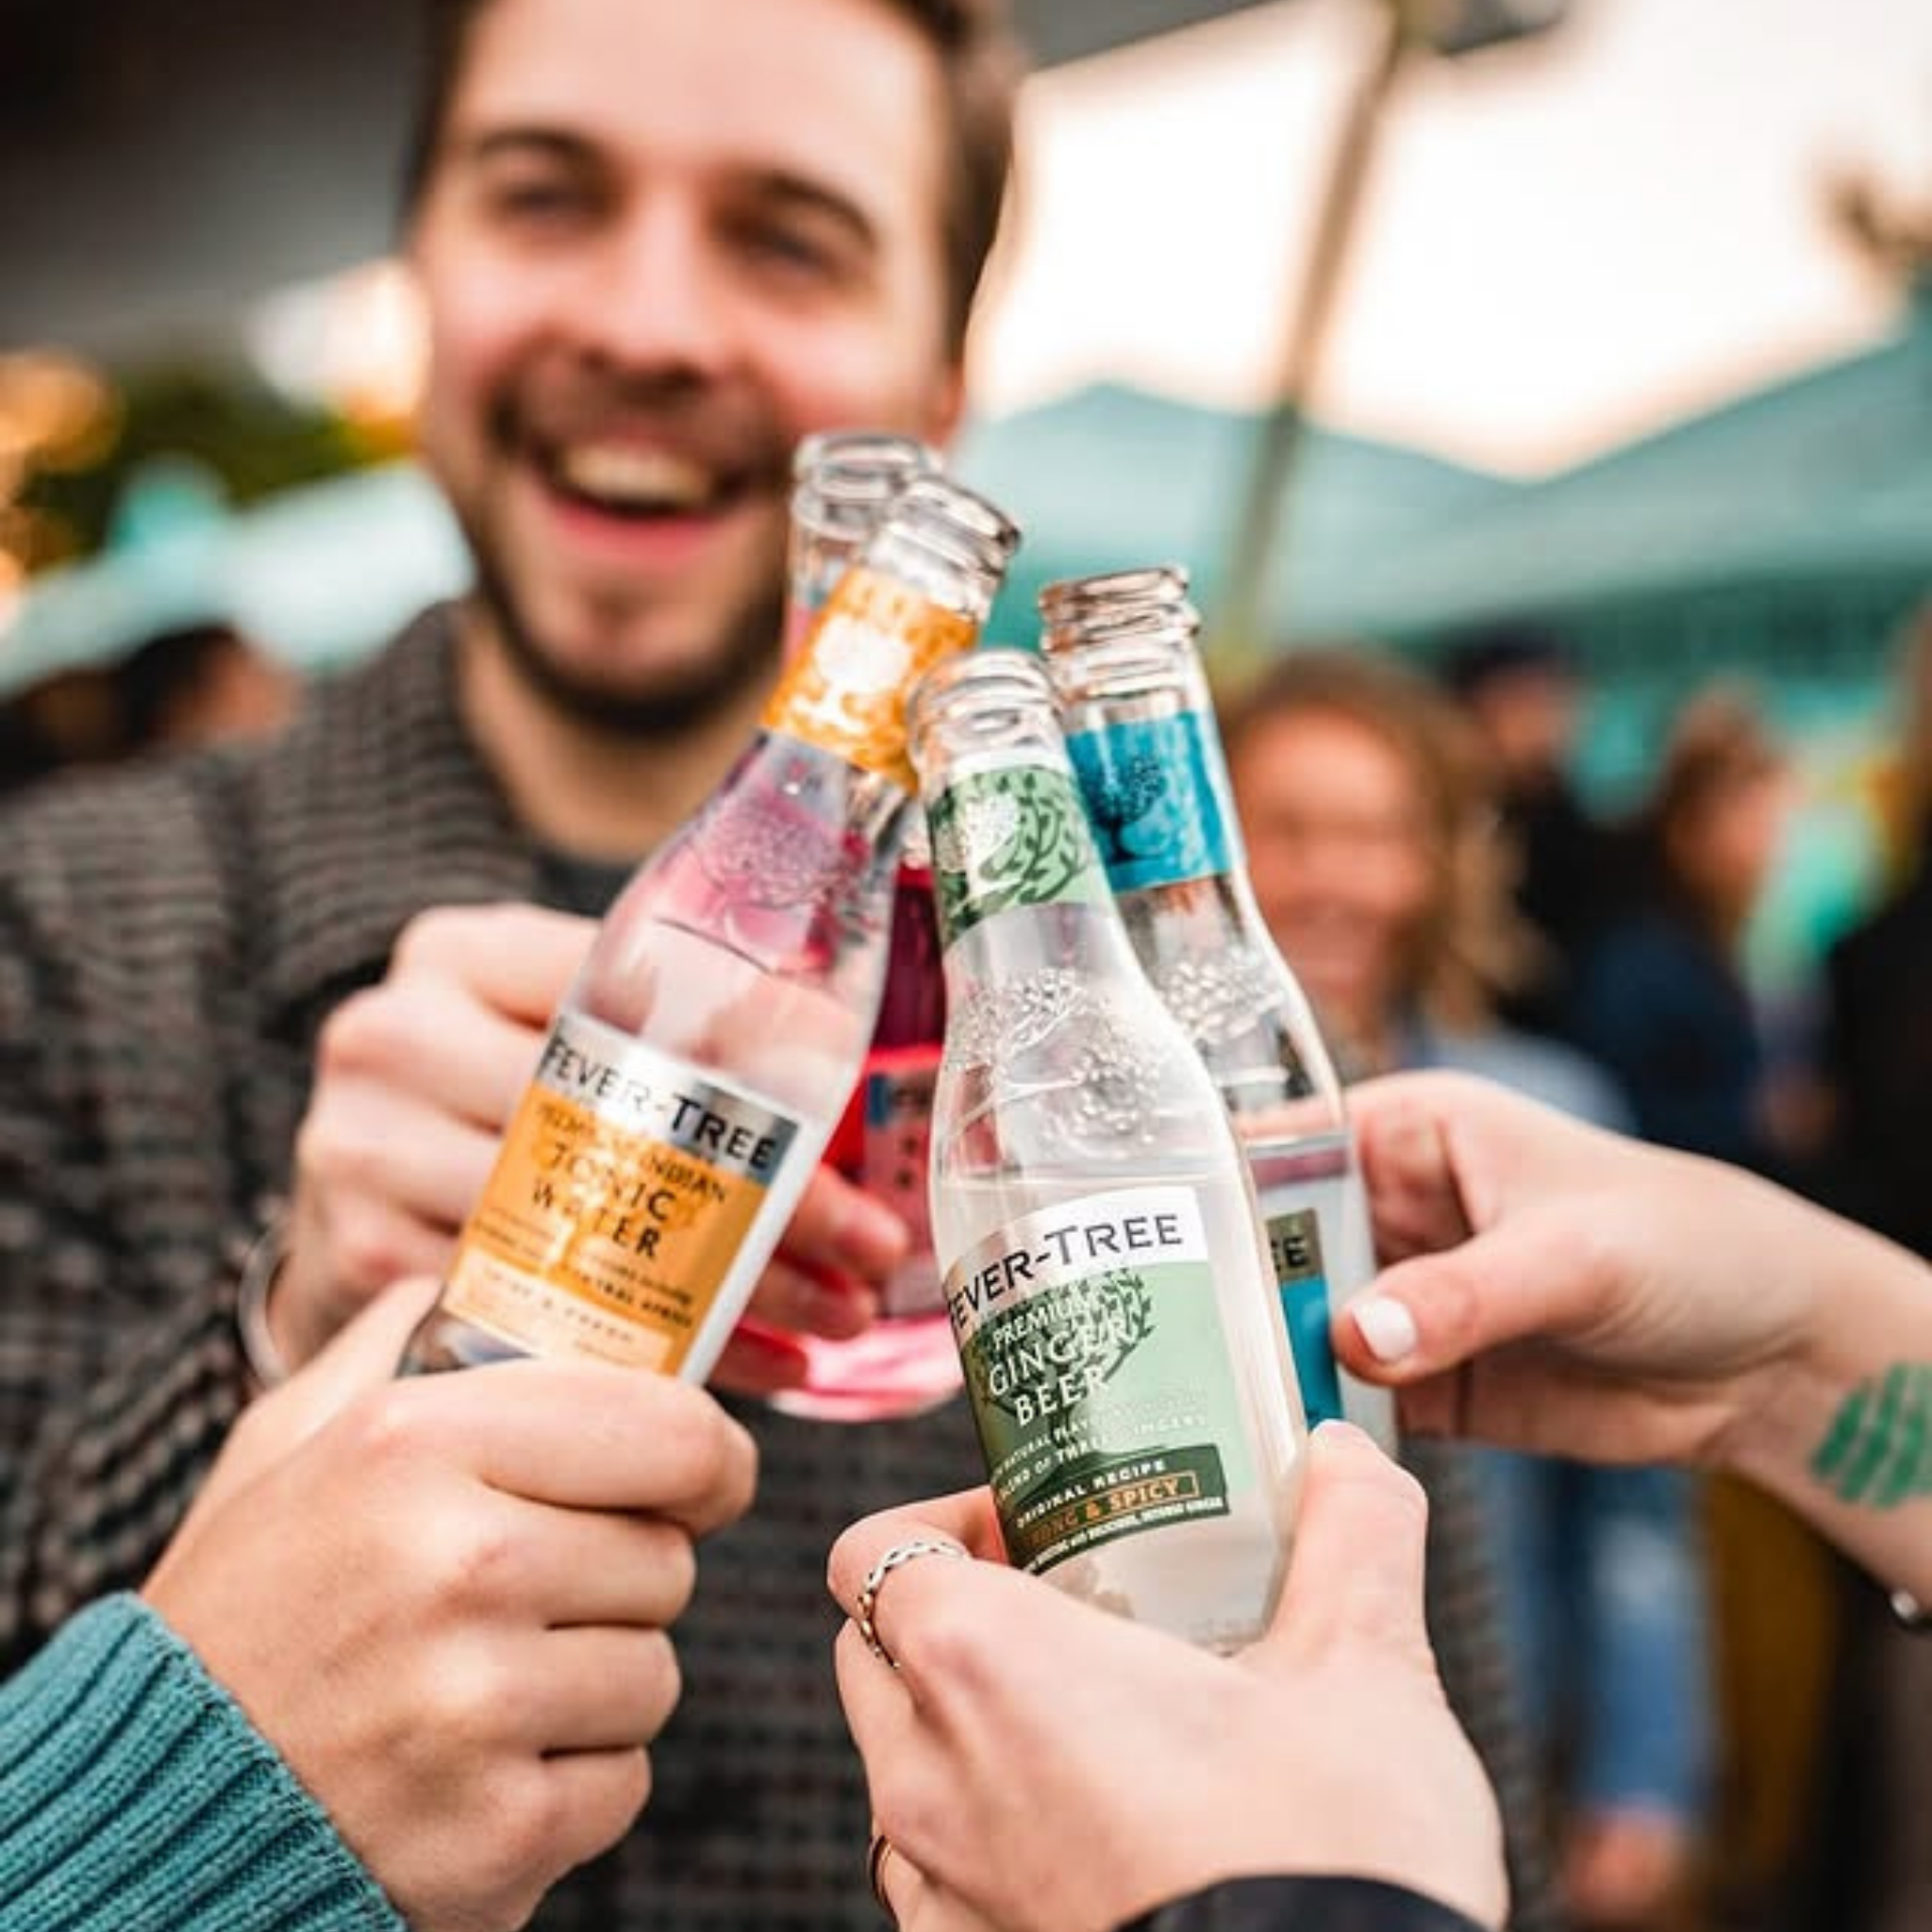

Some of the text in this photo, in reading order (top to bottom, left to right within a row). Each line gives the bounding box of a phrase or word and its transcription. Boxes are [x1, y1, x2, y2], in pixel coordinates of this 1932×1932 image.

[987, 1315, 1140, 1396] GINGER
[1014, 1364, 1111, 1427] BEER
[1085, 1498, 1102, 1520] &
[1108, 1476, 1181, 1511] SPICY
[1092, 1457, 1166, 1489] RECIPE
